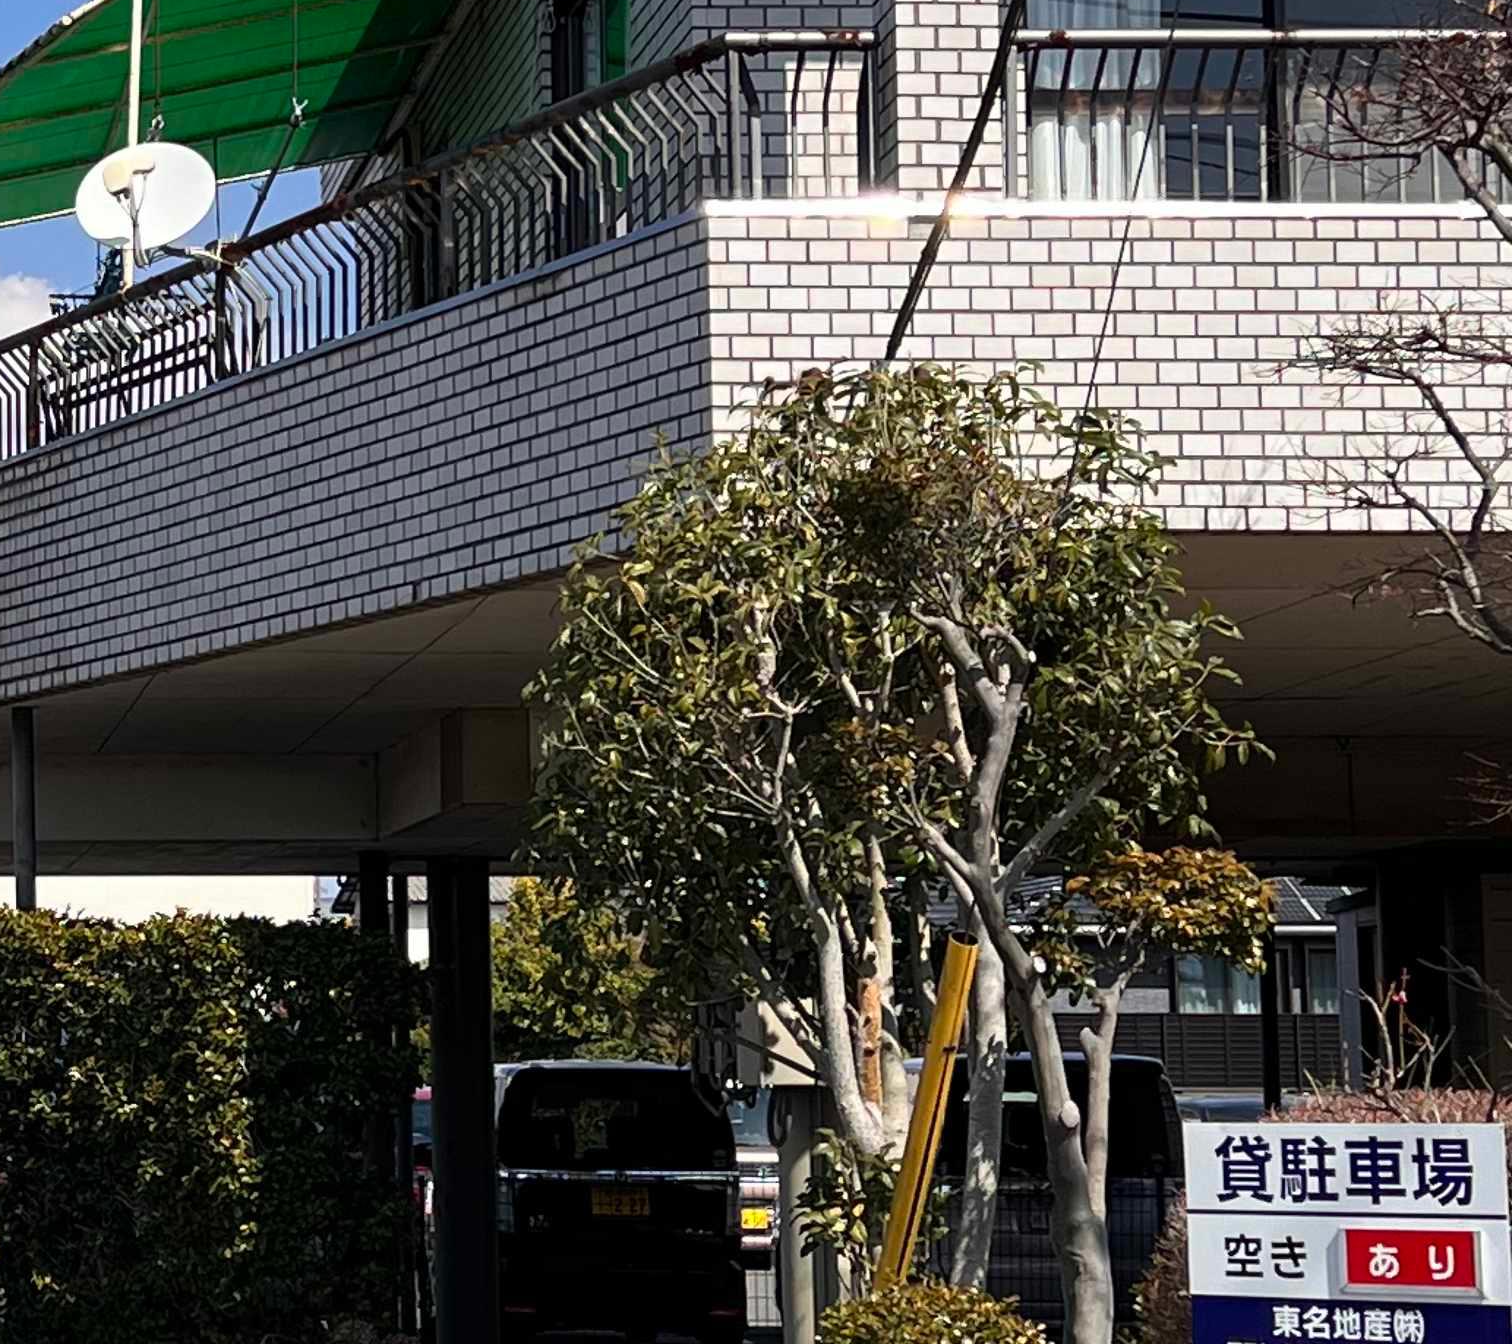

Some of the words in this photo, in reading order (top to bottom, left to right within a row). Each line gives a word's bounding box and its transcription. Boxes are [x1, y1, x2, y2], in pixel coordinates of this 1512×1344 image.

[1215, 1135, 1474, 1206] 貸駐車場
[1224, 1234, 1307, 1279] 空き
[1369, 1243, 1455, 1280] あり
